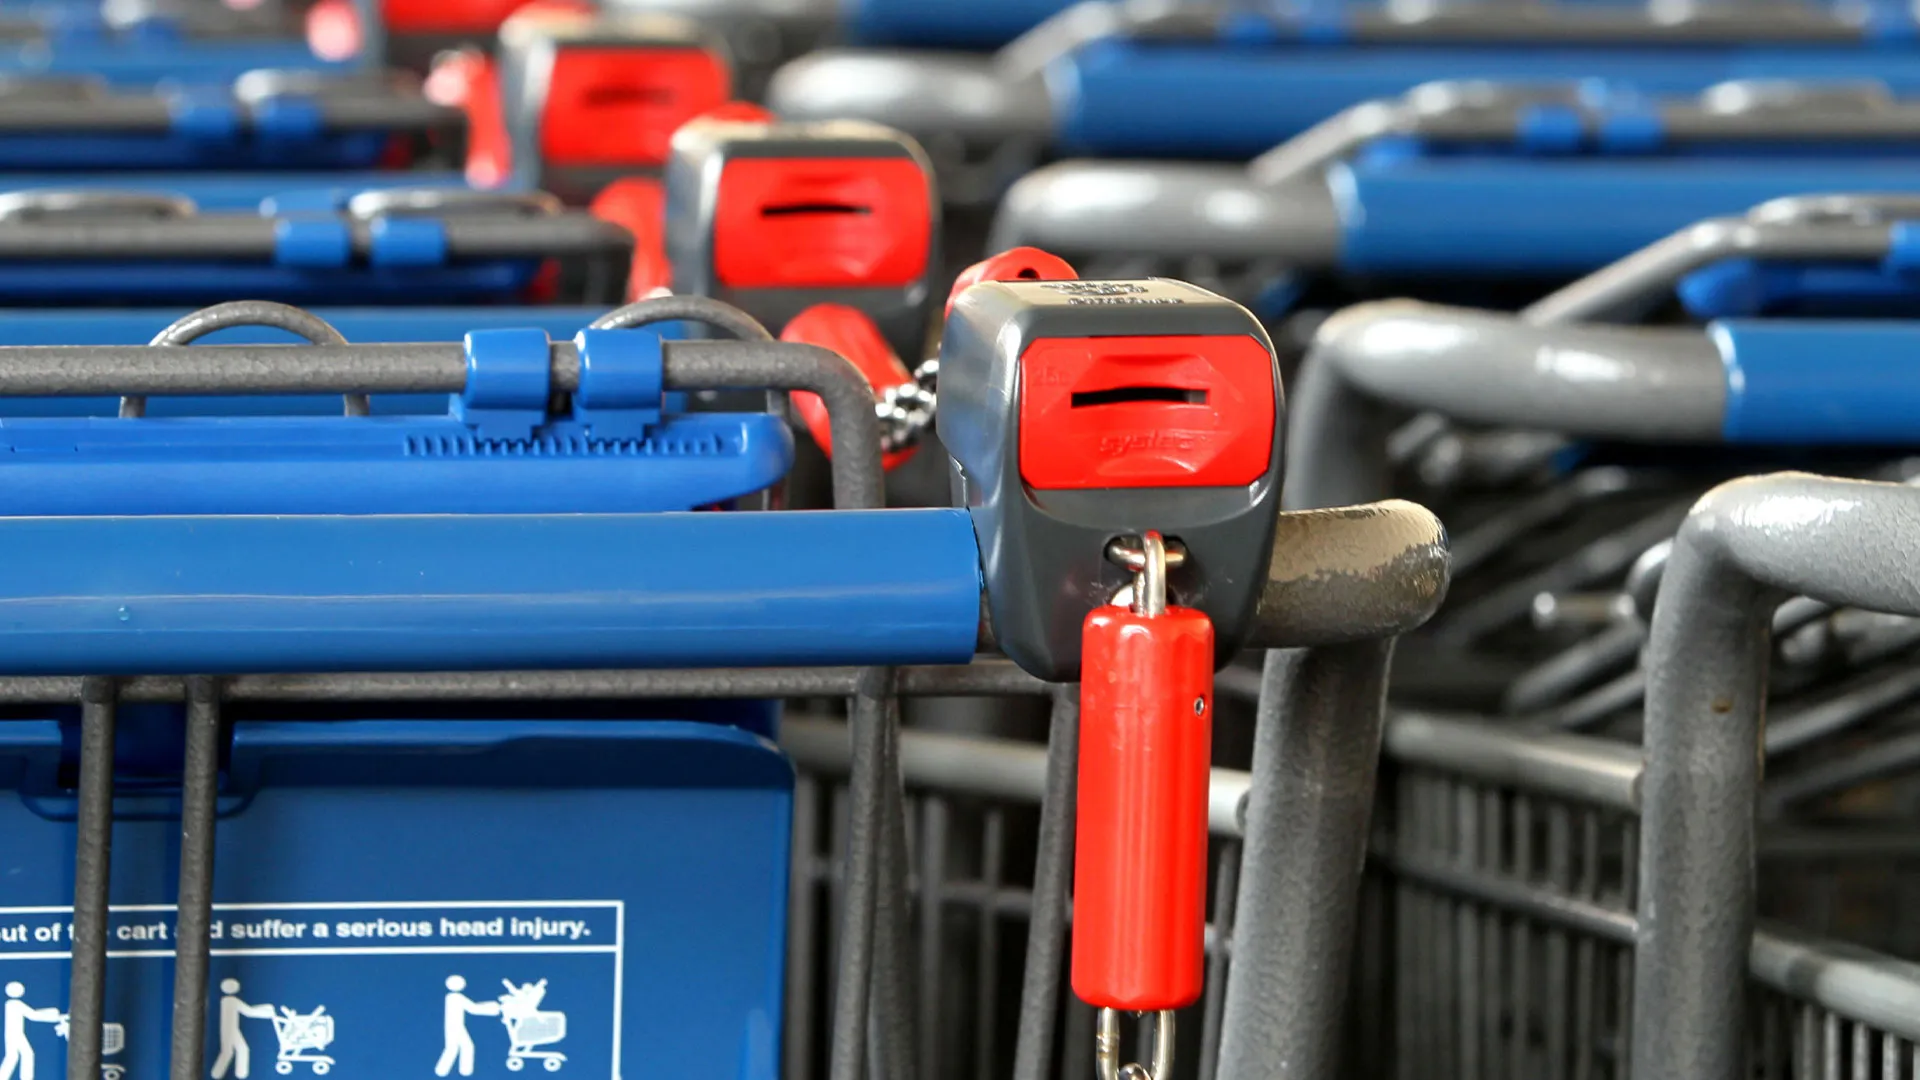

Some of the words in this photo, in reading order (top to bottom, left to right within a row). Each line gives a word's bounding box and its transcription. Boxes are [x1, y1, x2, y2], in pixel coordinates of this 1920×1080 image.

[0, 924, 28, 942] ut
[34, 922, 62, 942] of
[116, 921, 168, 940] cart
[230, 919, 307, 938] suffer
[312, 923, 329, 938] a
[336, 918, 432, 937] serious
[440, 917, 503, 936] head
[511, 917, 592, 940] injury.
